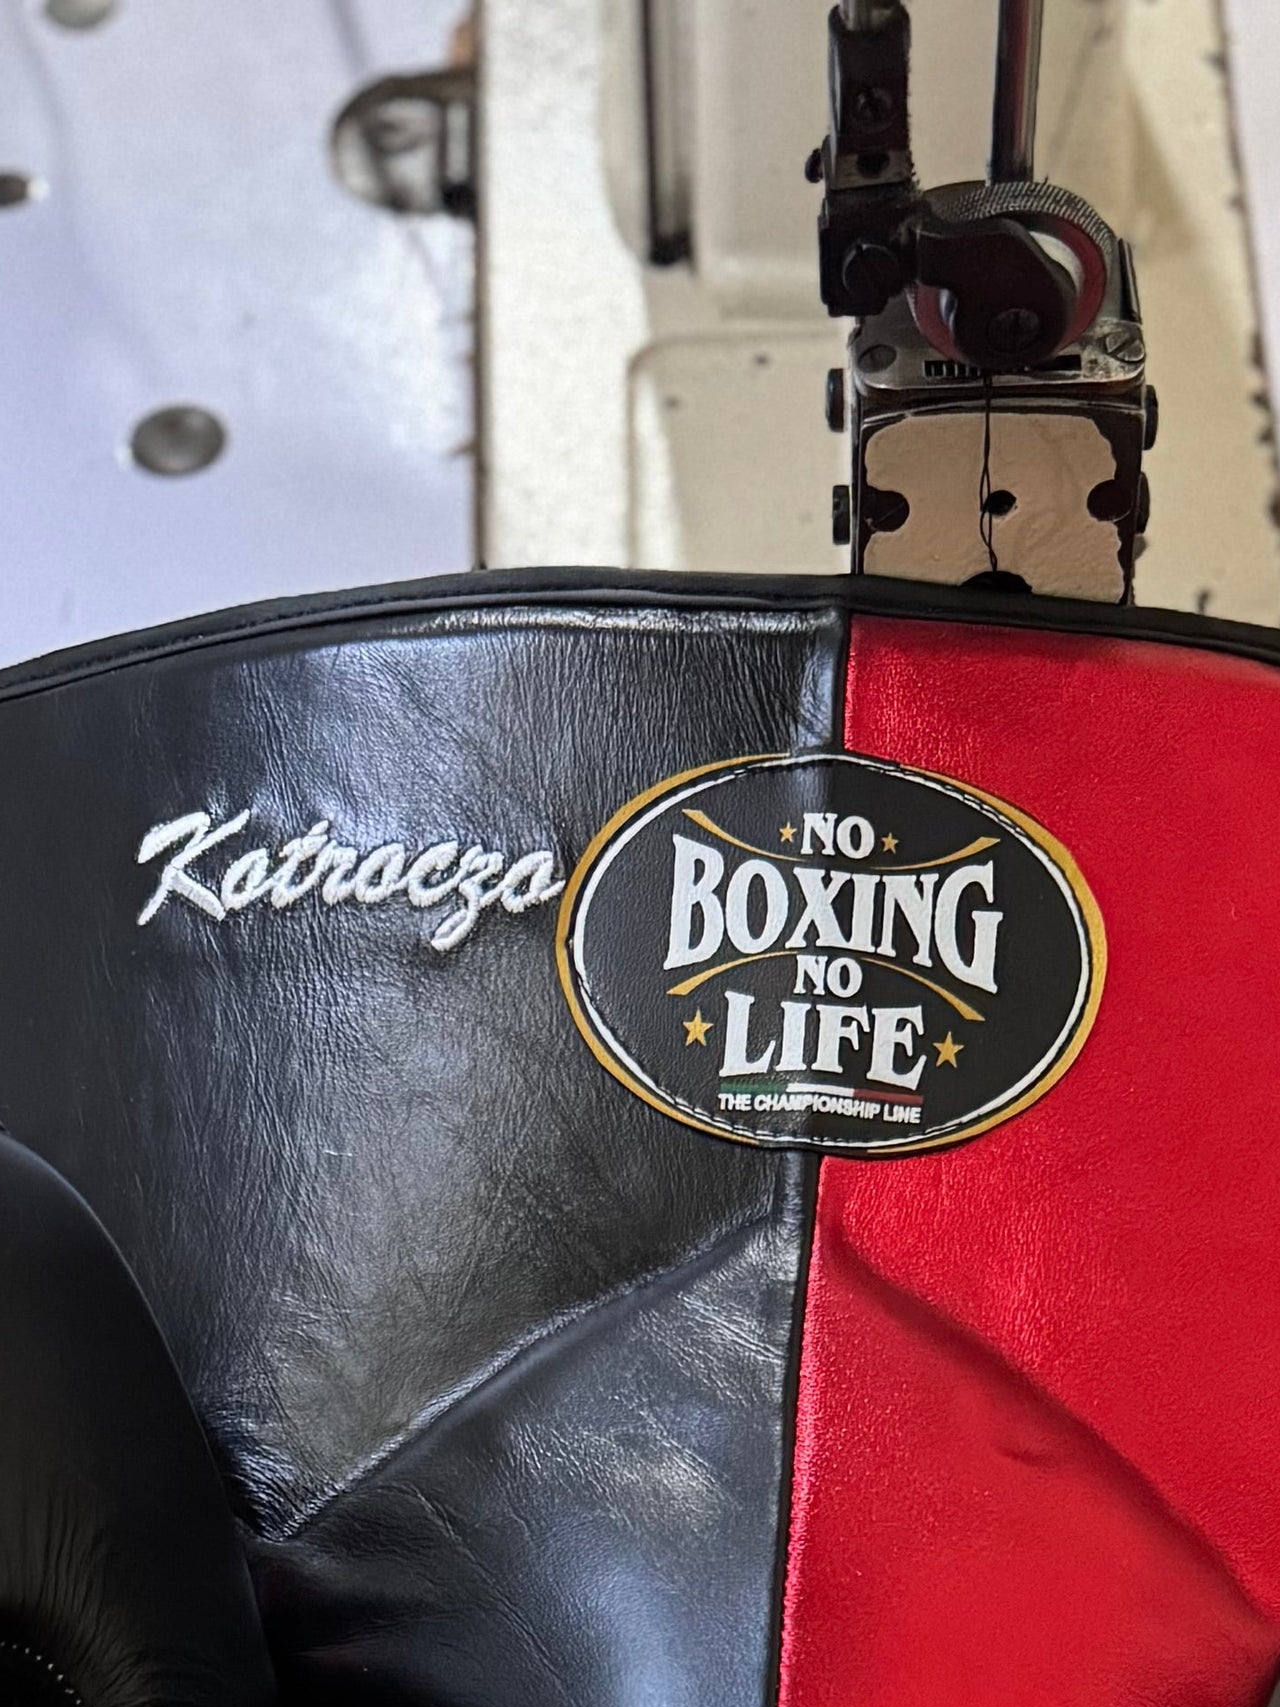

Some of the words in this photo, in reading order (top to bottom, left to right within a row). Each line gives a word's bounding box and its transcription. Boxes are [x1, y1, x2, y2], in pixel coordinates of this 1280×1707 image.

[801, 813, 876, 860] NO
[663, 834, 1003, 995] BOXING
[793, 954, 863, 998] NO
[718, 991, 929, 1090] LIFE
[718, 1092, 752, 1112] THE
[753, 1093, 881, 1121] CHAMPIONSHIP
[882, 1102, 922, 1124] LINE
